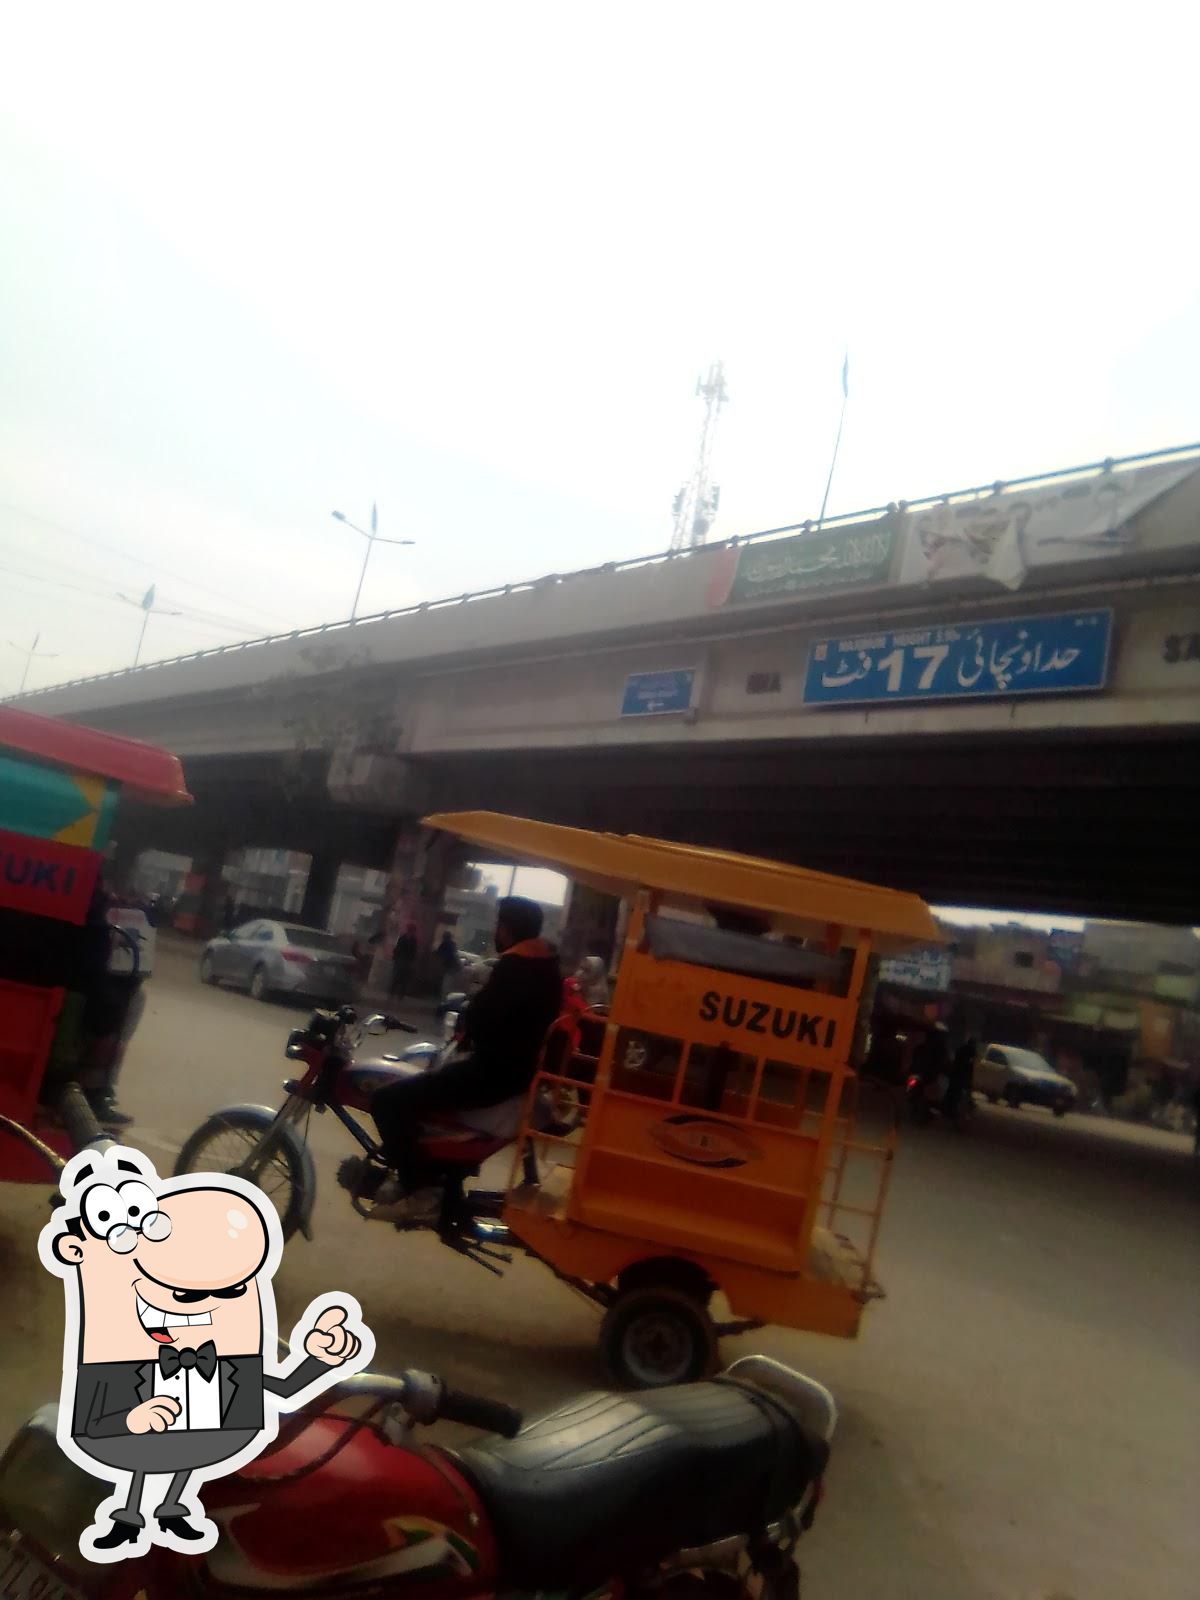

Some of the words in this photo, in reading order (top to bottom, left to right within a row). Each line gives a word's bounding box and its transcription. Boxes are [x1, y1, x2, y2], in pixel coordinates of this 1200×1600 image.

[877, 645, 949, 692] 17
[0, 850, 77, 895] UKI
[699, 991, 837, 1048] SUZUKI
